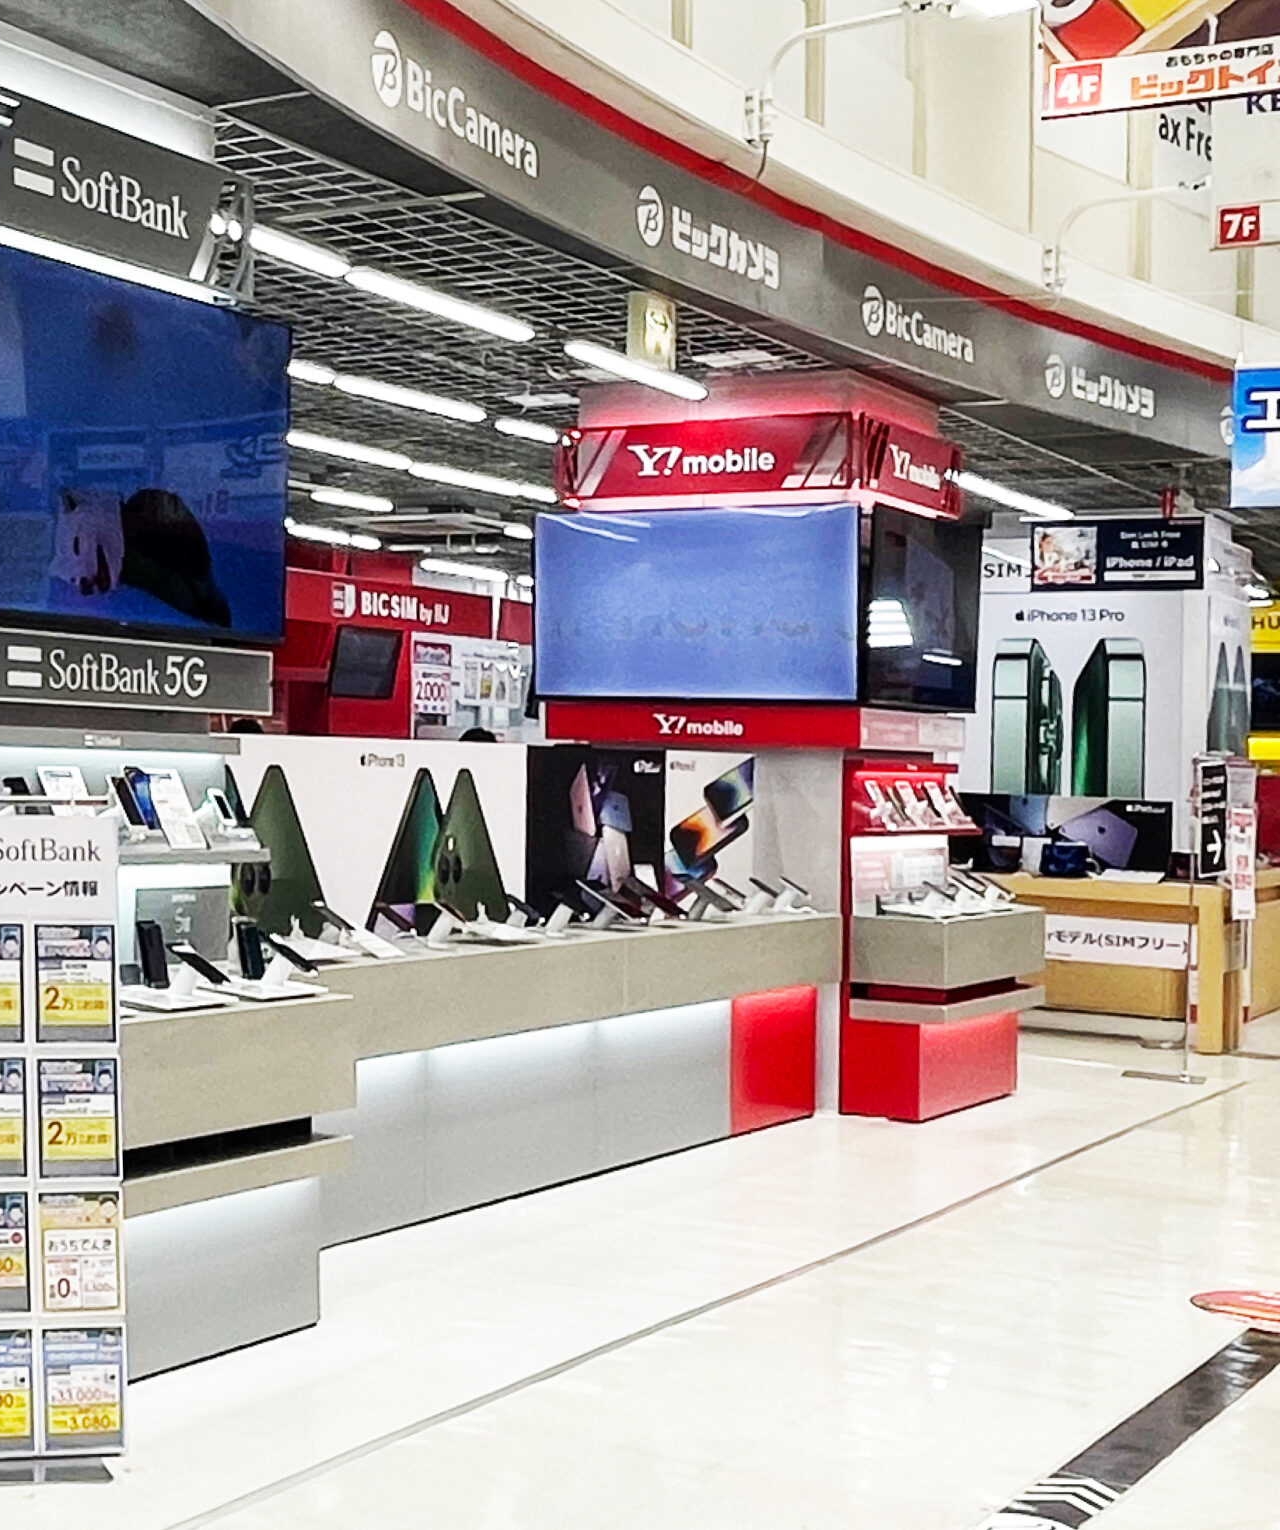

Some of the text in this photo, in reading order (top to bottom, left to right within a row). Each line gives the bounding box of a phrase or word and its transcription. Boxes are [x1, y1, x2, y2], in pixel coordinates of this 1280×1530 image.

[1056, 73, 1099, 104] 4F
[1131, 59, 1280, 101] ビックトイ
[404, 57, 539, 178] BicCamera
[60, 156, 189, 240] SoftBank
[670, 205, 780, 290] ビックカメラ
[1223, 213, 1257, 240] 7F
[885, 301, 975, 364] BicCamera
[1071, 366, 1155, 419] ビックカメラ
[1106, 556, 1153, 569] iPhone
[1164, 554, 1194, 568] iPad
[1027, 609, 1124, 621] iPhone 13 Pro
[47, 645, 209, 698] SoftBank 5G
[48, 1239, 112, 1253] おうちでんき
